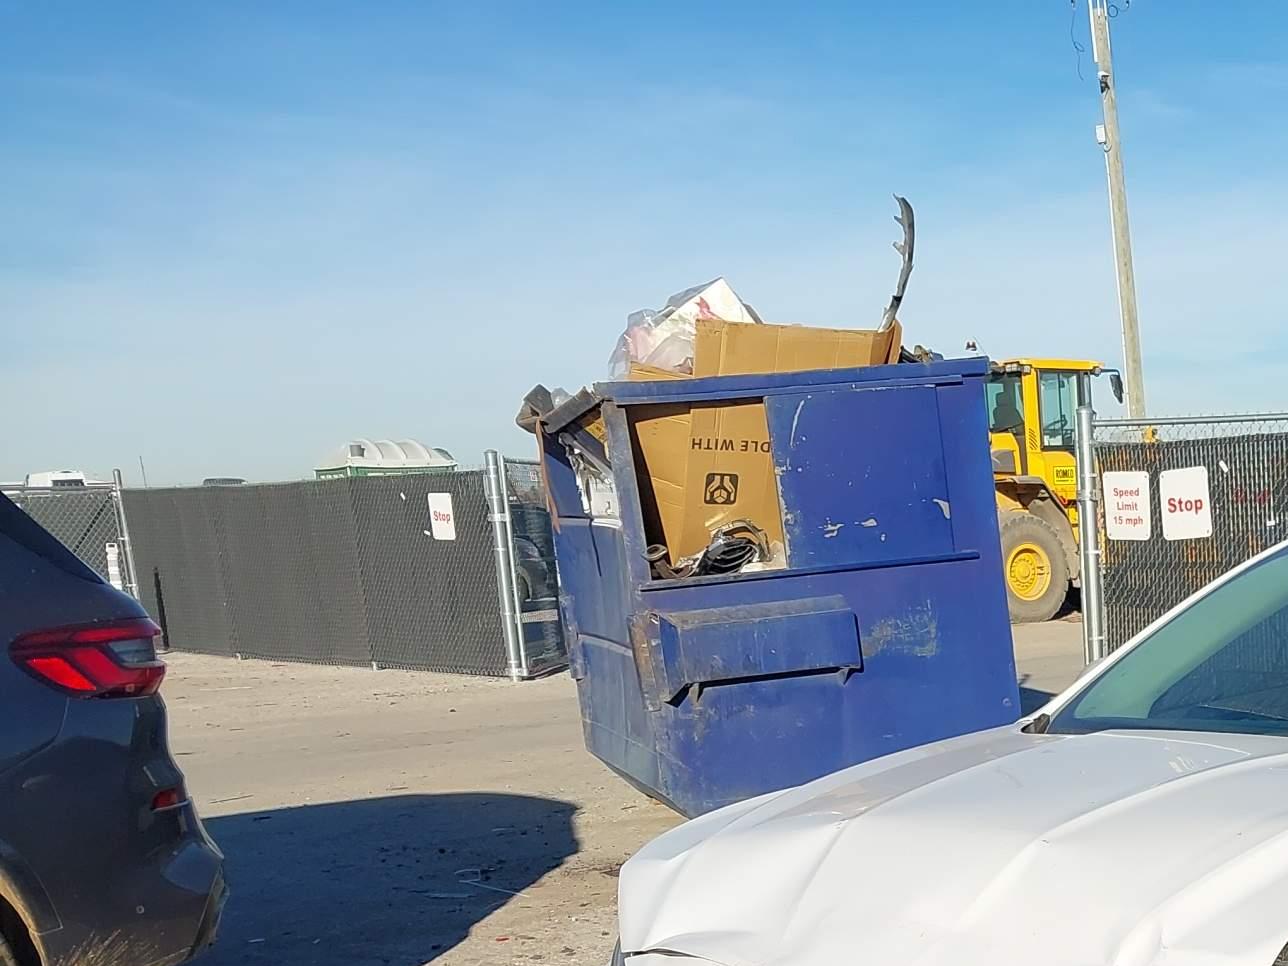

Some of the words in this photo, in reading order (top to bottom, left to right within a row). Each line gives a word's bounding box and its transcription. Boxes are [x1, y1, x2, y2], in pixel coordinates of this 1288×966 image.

[691, 437, 735, 451] WITH
[1113, 487, 1140, 499] Speed
[1116, 501, 1138, 511] Limit
[1167, 497, 1203, 515] Stop
[433, 510, 451, 524] Stop
[1113, 516, 1123, 525] 15
[1126, 515, 1144, 527] mph
